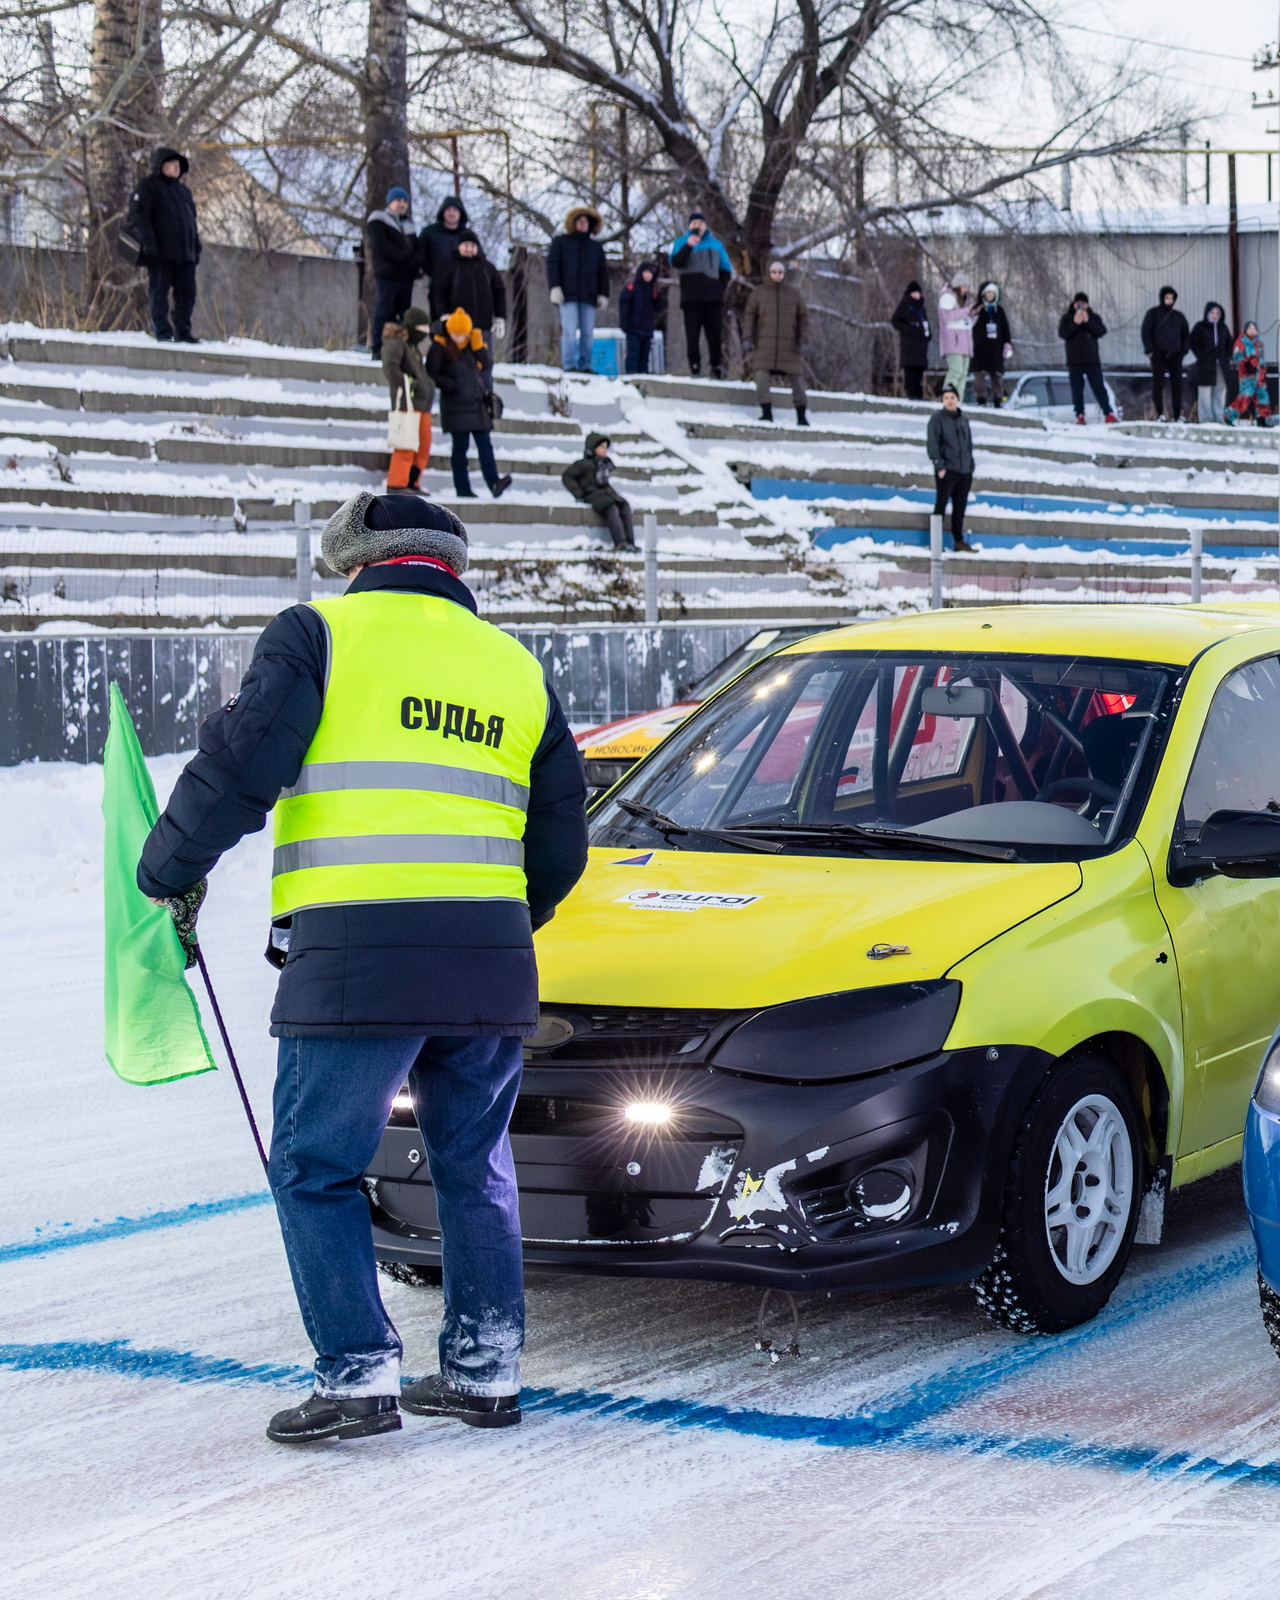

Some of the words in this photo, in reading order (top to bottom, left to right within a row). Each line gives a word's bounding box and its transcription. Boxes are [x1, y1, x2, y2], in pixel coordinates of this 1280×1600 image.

[401, 696, 505, 749] СУДЬЯ
[595, 744, 651, 755] НОВОСИБ
[660, 893, 757, 905] eurol
